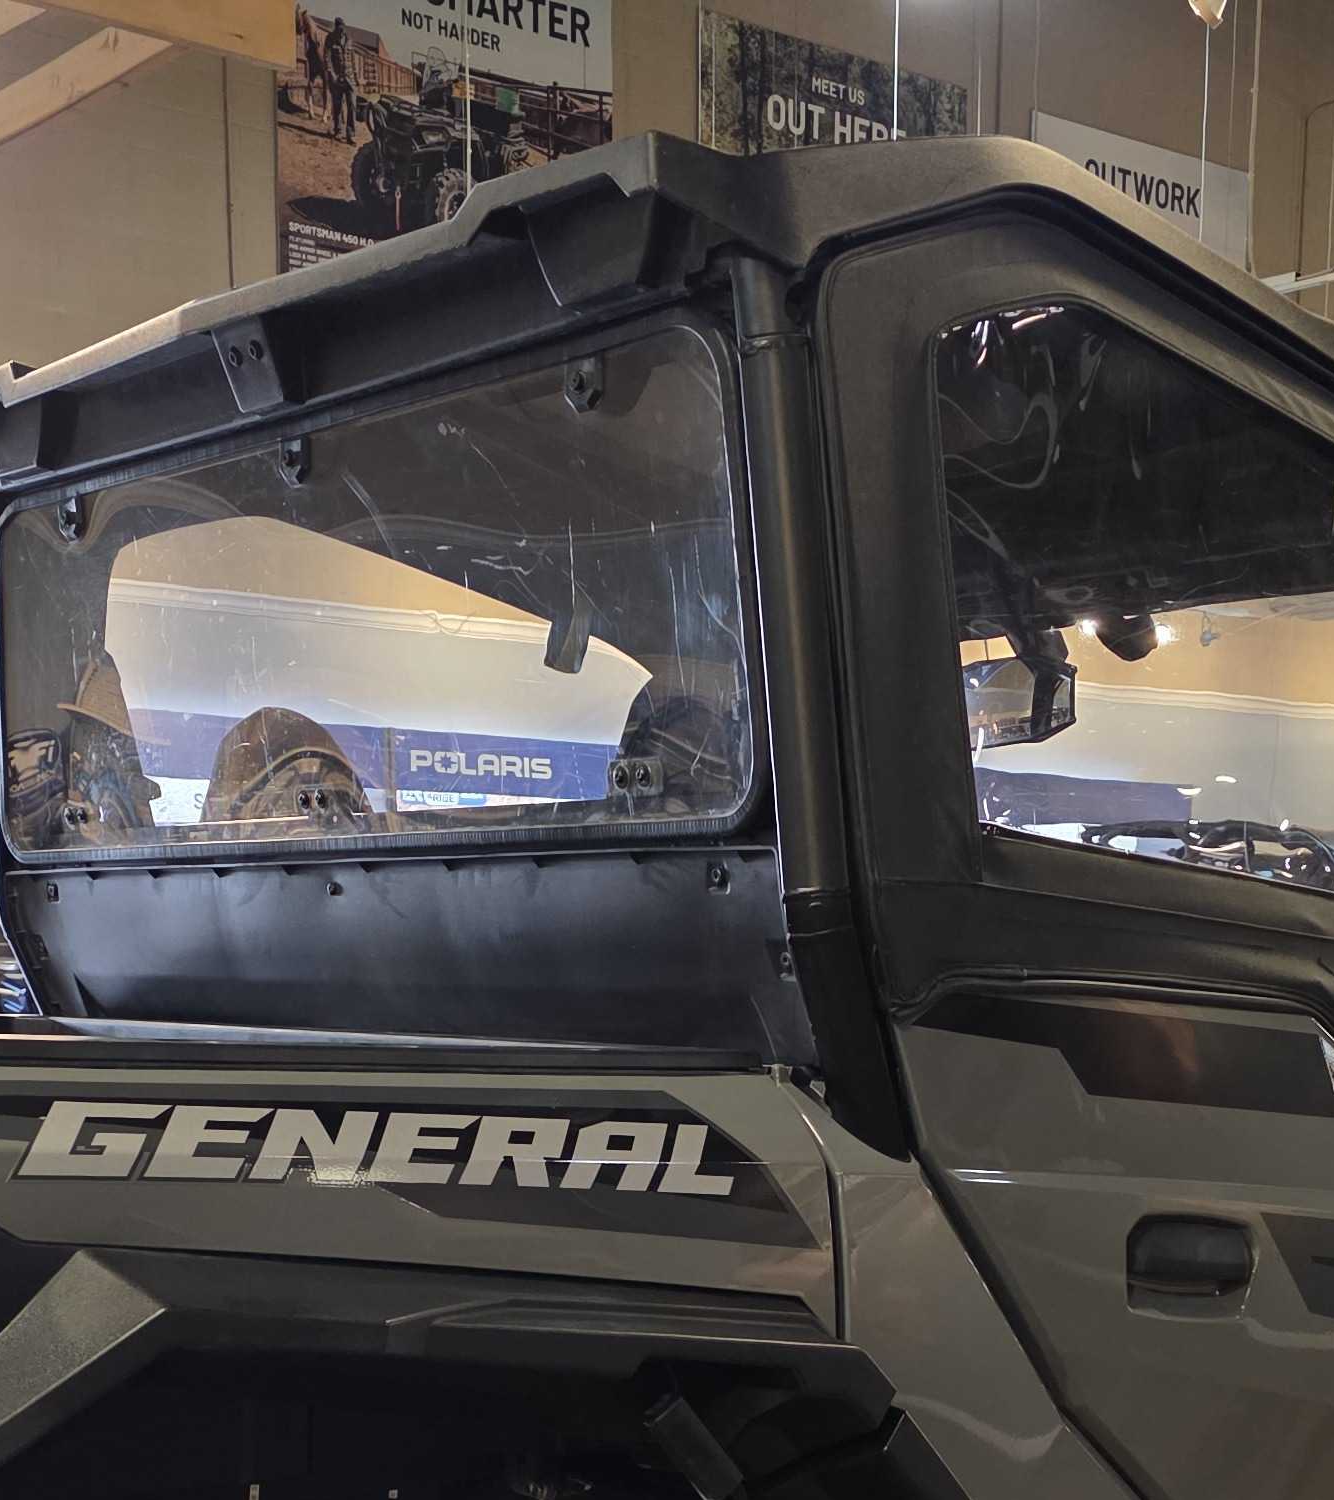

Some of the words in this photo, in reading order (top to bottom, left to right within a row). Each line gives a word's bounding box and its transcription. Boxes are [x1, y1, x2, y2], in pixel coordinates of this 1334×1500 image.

[401, 7, 434, 32] NOT
[437, 20, 501, 52] HARDER
[426, 0, 590, 48] ARTER
[811, 76, 846, 100] MEET
[848, 86, 865, 106] US
[767, 94, 826, 140] OUT
[834, 111, 907, 145] HER
[288, 221, 341, 242] SPORTSMAN
[410, 749, 552, 780] POLARIS
[6, 1099, 734, 1197] GENERAL
